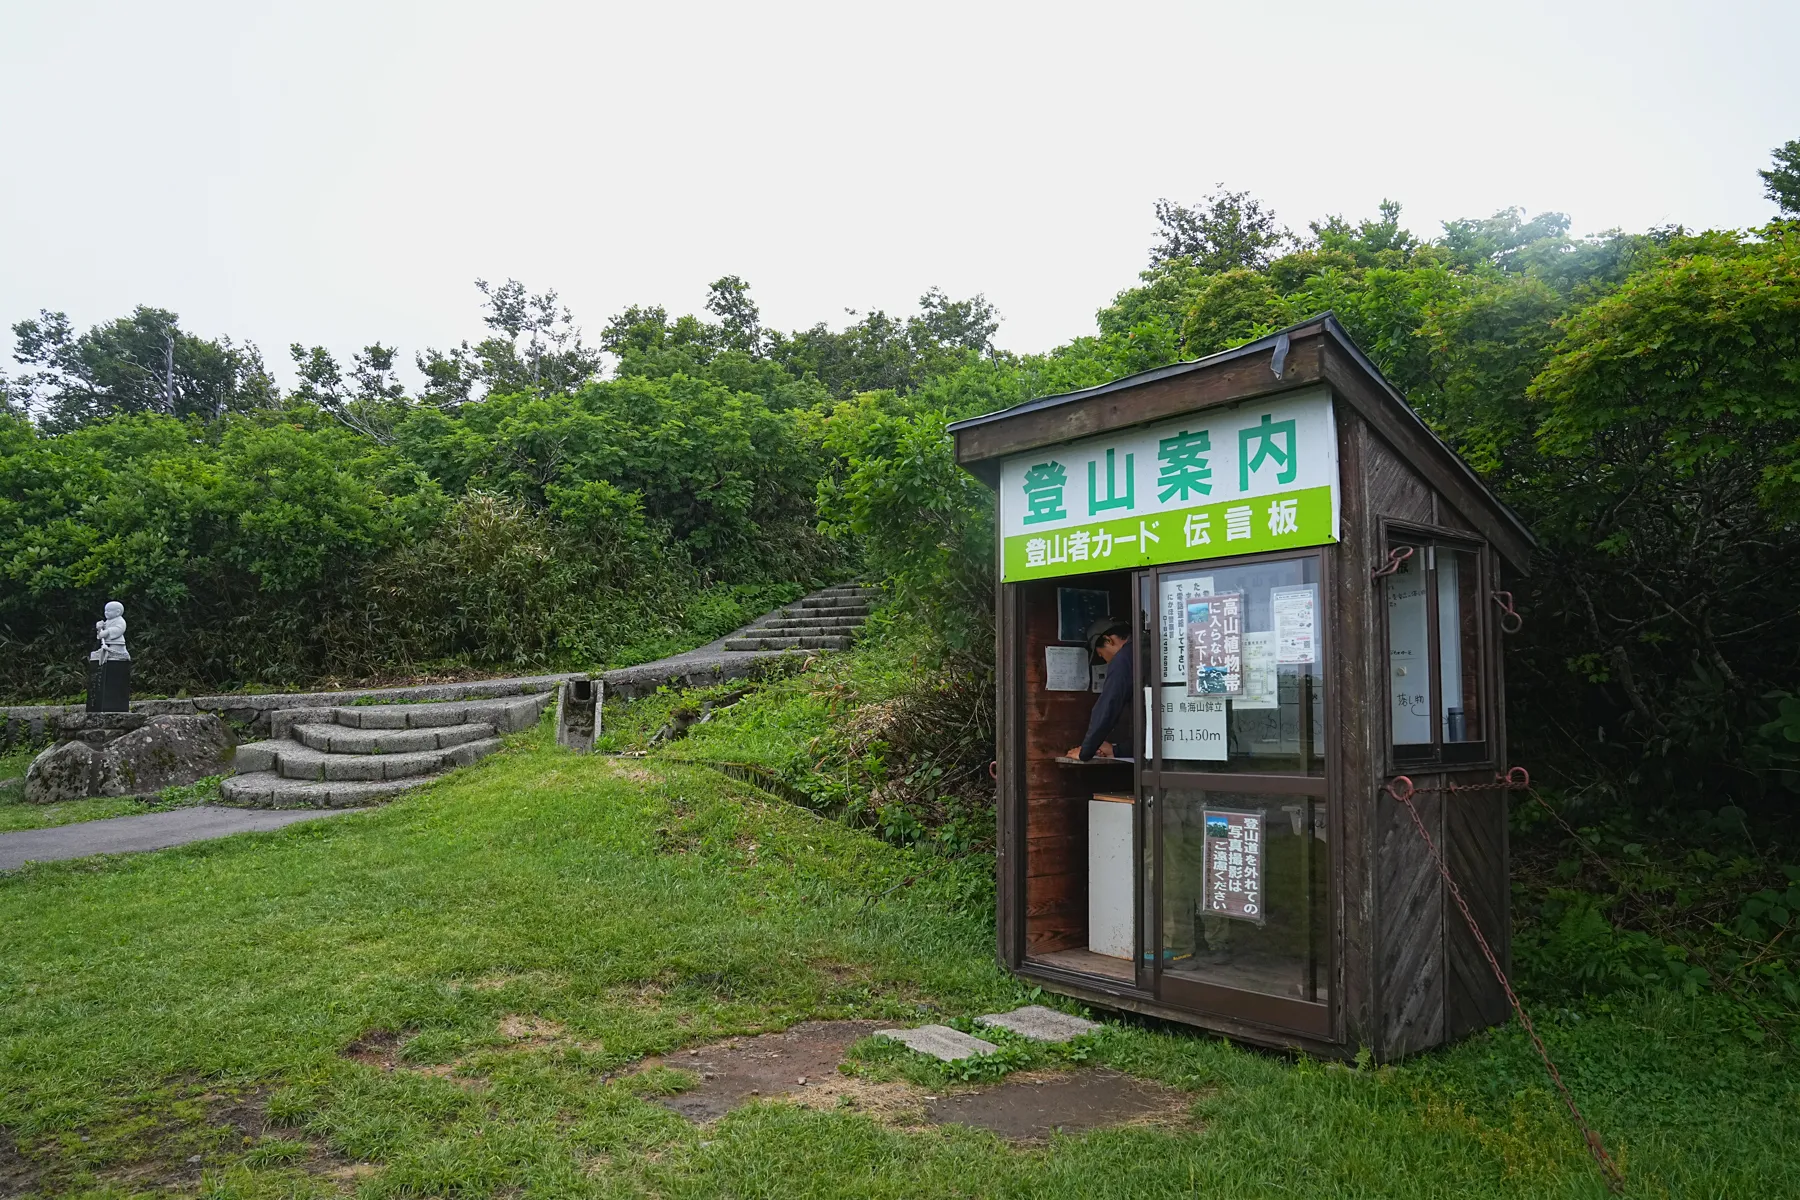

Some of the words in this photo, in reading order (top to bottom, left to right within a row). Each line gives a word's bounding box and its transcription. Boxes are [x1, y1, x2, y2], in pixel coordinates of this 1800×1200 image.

[1022, 413, 1298, 526] 登山案内
[1025, 520, 1160, 568] 登山者カード
[1183, 499, 1299, 548] 伝言板
[1194, 629, 1208, 693] で下さい
[1208, 602, 1222, 667] に入らない
[1222, 597, 1240, 692] 高山植物帯
[1160, 702, 1174, 713] 合目
[1161, 727, 1175, 742] 高
[1179, 728, 1221, 743] 1,150m
[1213, 841, 1228, 910] ご遠慮ください
[1228, 825, 1243, 893] 写真撮影は
[1243, 817, 1259, 915] 登山道を外れての
